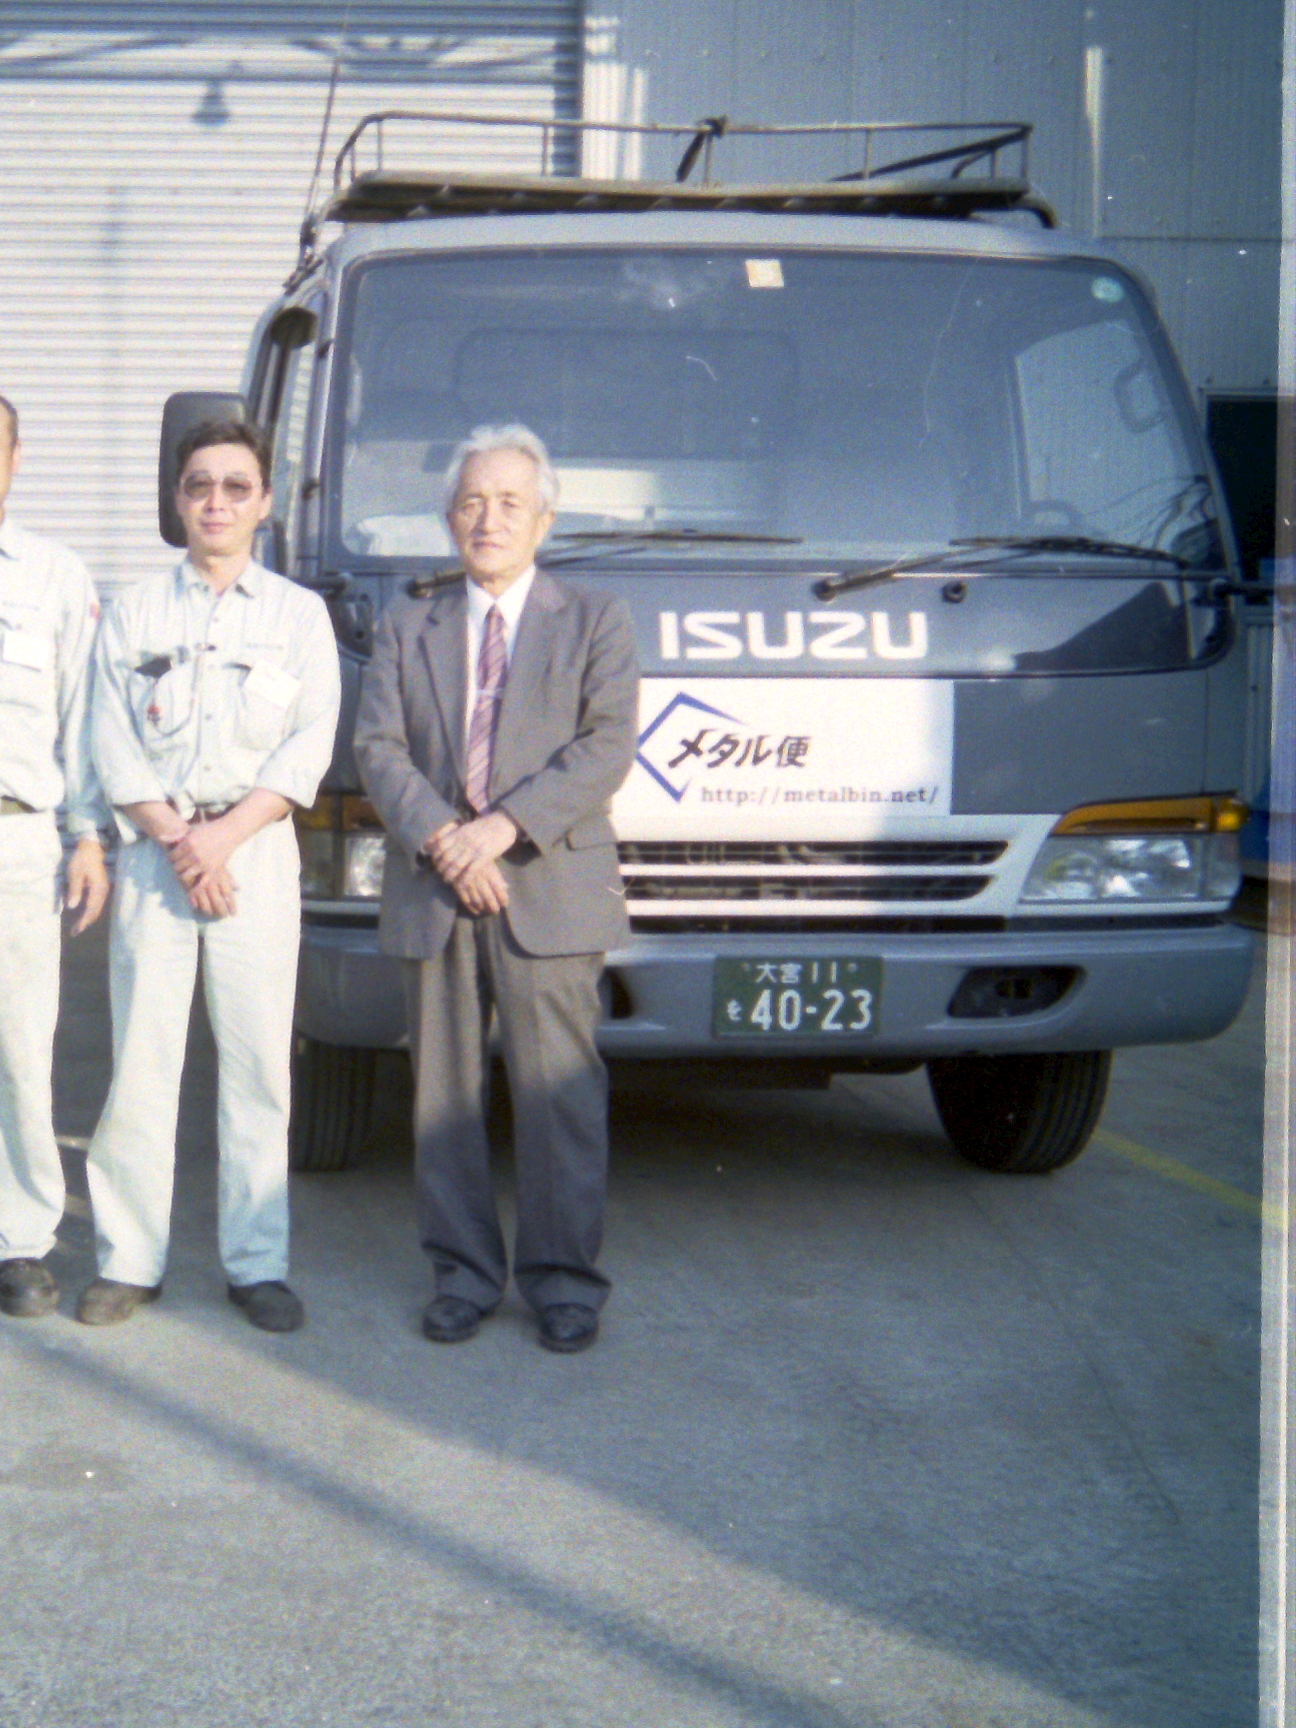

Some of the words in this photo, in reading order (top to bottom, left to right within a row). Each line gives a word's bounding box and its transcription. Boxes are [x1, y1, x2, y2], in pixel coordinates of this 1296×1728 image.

[659, 611, 928, 660] ISUZU
[668, 729, 811, 768] メタル便
[702, 785, 939, 806] http://metalbin.net/
[755, 962, 802, 984] 大宮
[811, 961, 837, 983] 11
[751, 989, 872, 1031] 40-23
